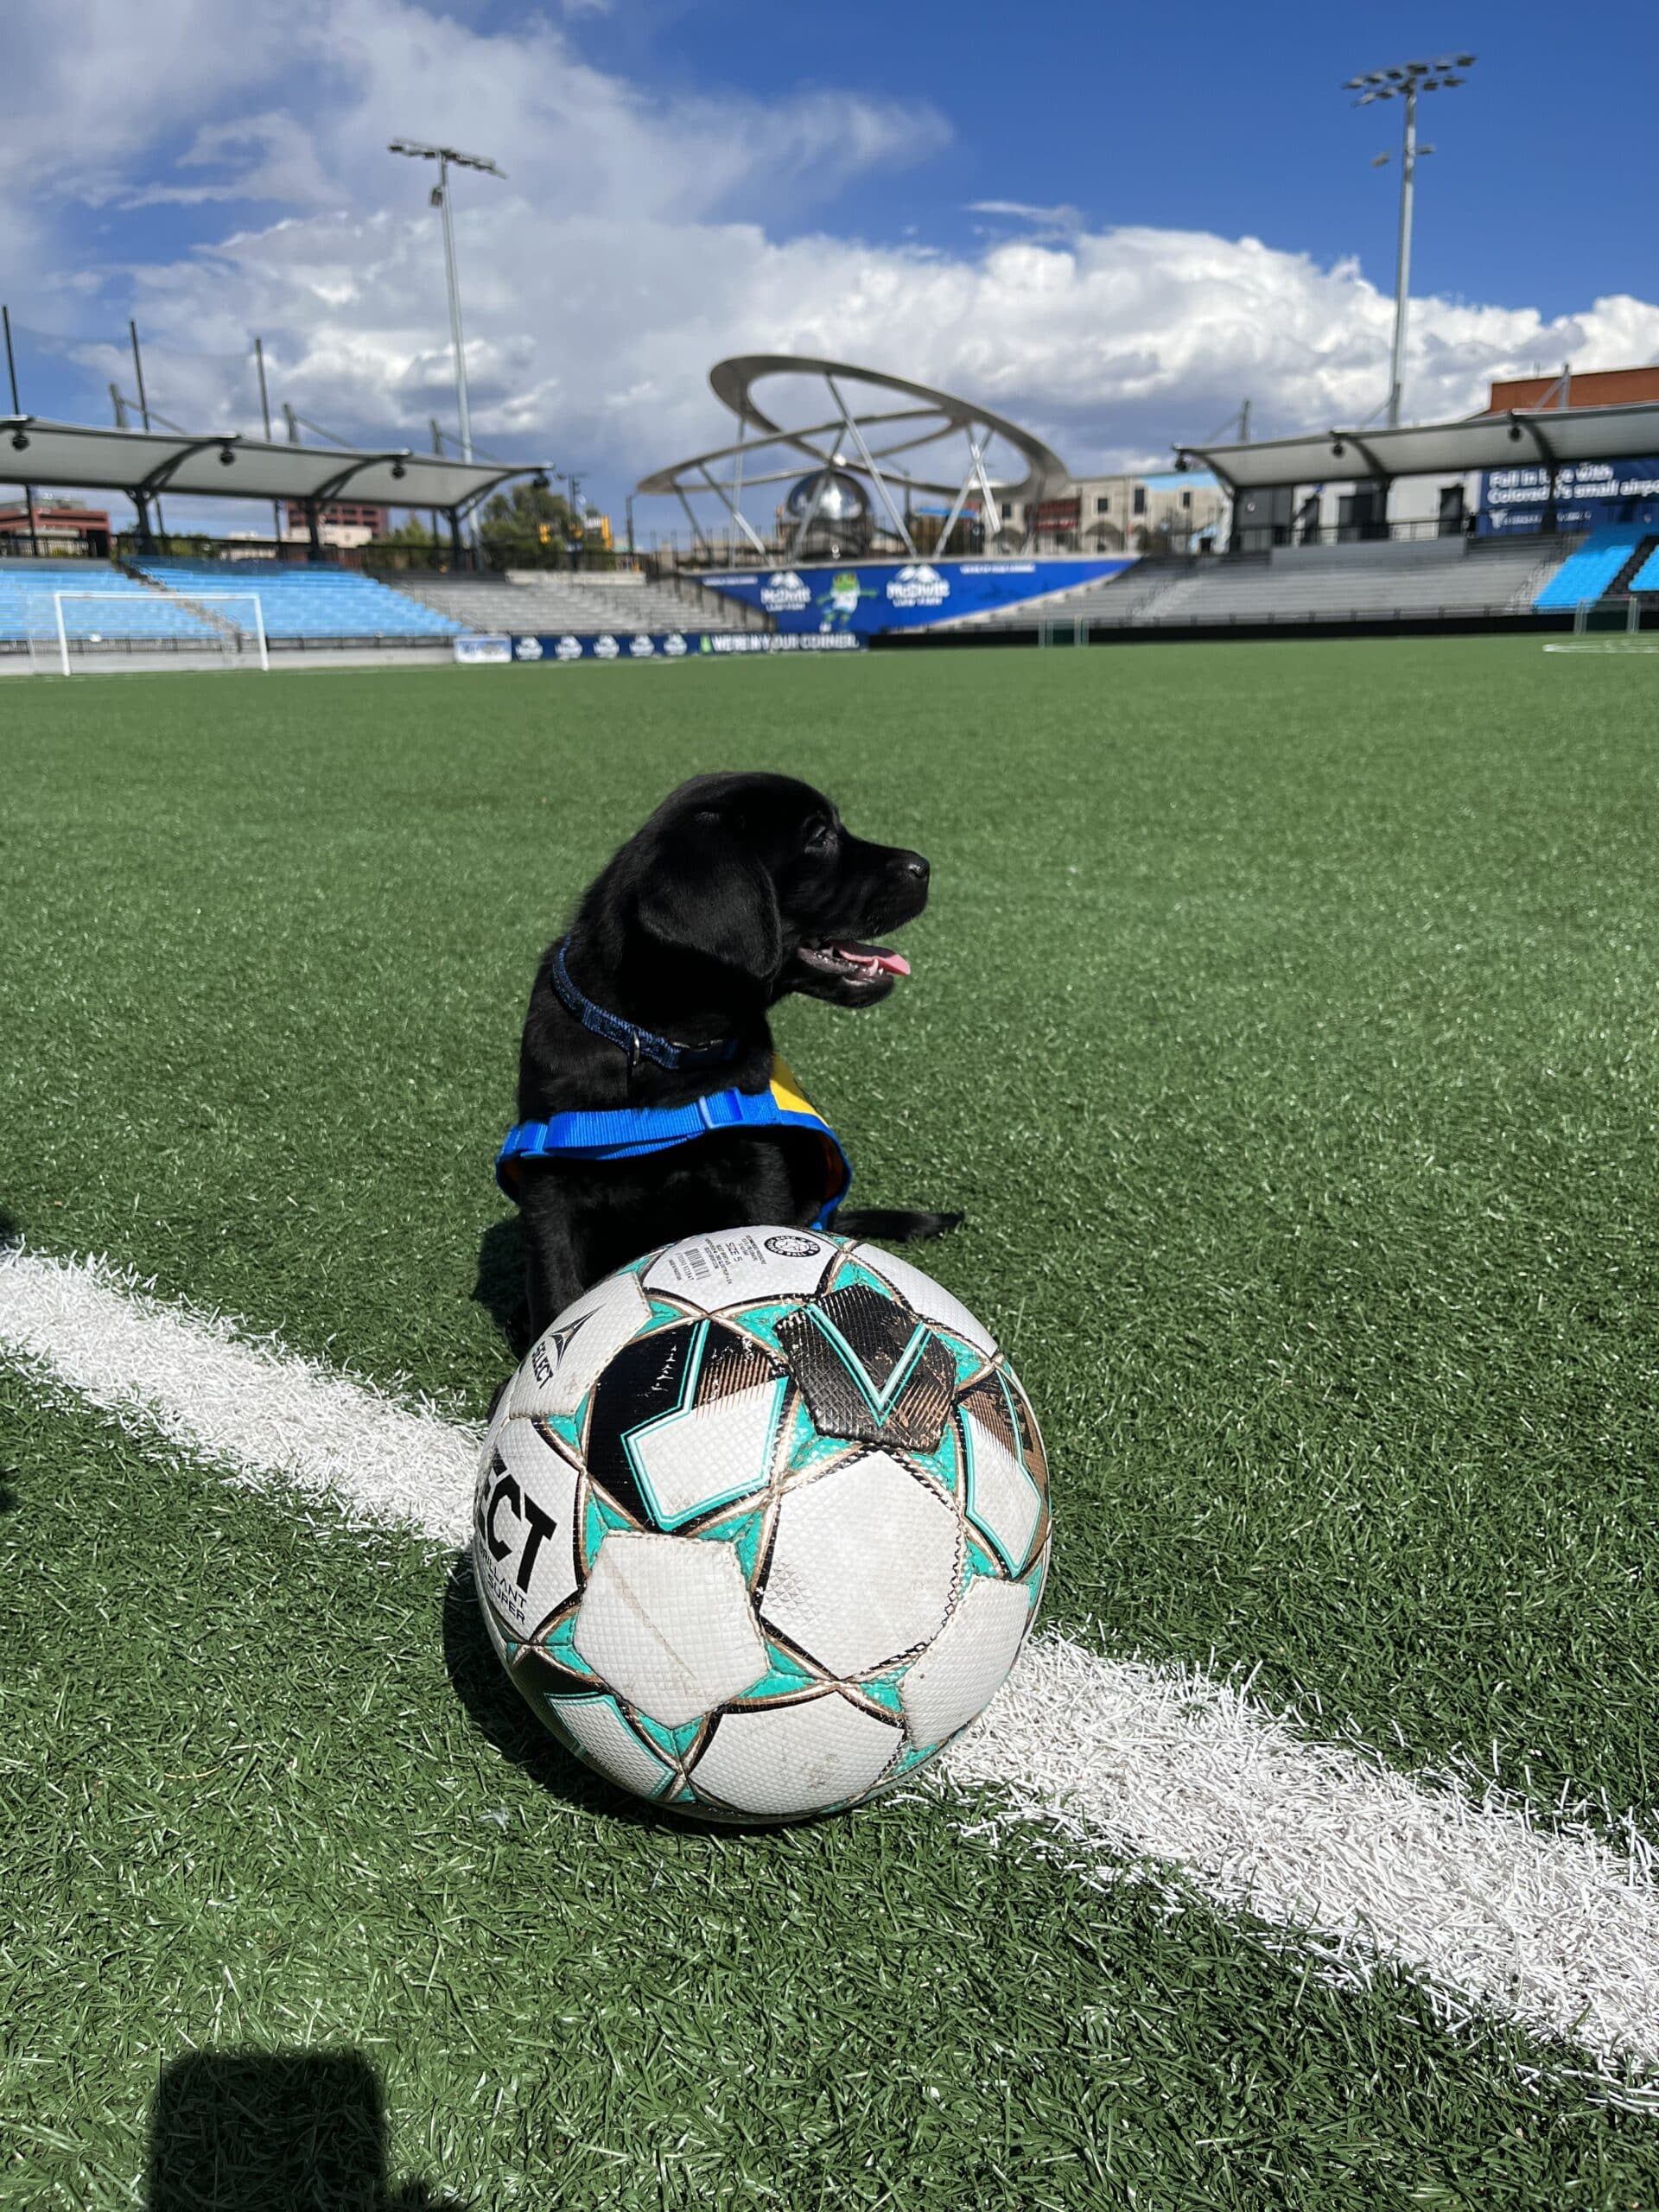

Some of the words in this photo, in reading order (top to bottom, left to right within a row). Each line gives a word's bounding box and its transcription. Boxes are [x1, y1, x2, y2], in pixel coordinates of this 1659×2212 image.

[1490, 471, 1520, 489] Fall
[1521, 470, 1537, 486] in
[1575, 461, 1614, 482] with
[1573, 479, 1619, 499] small
[487, 1573, 526, 1625] SUPER
